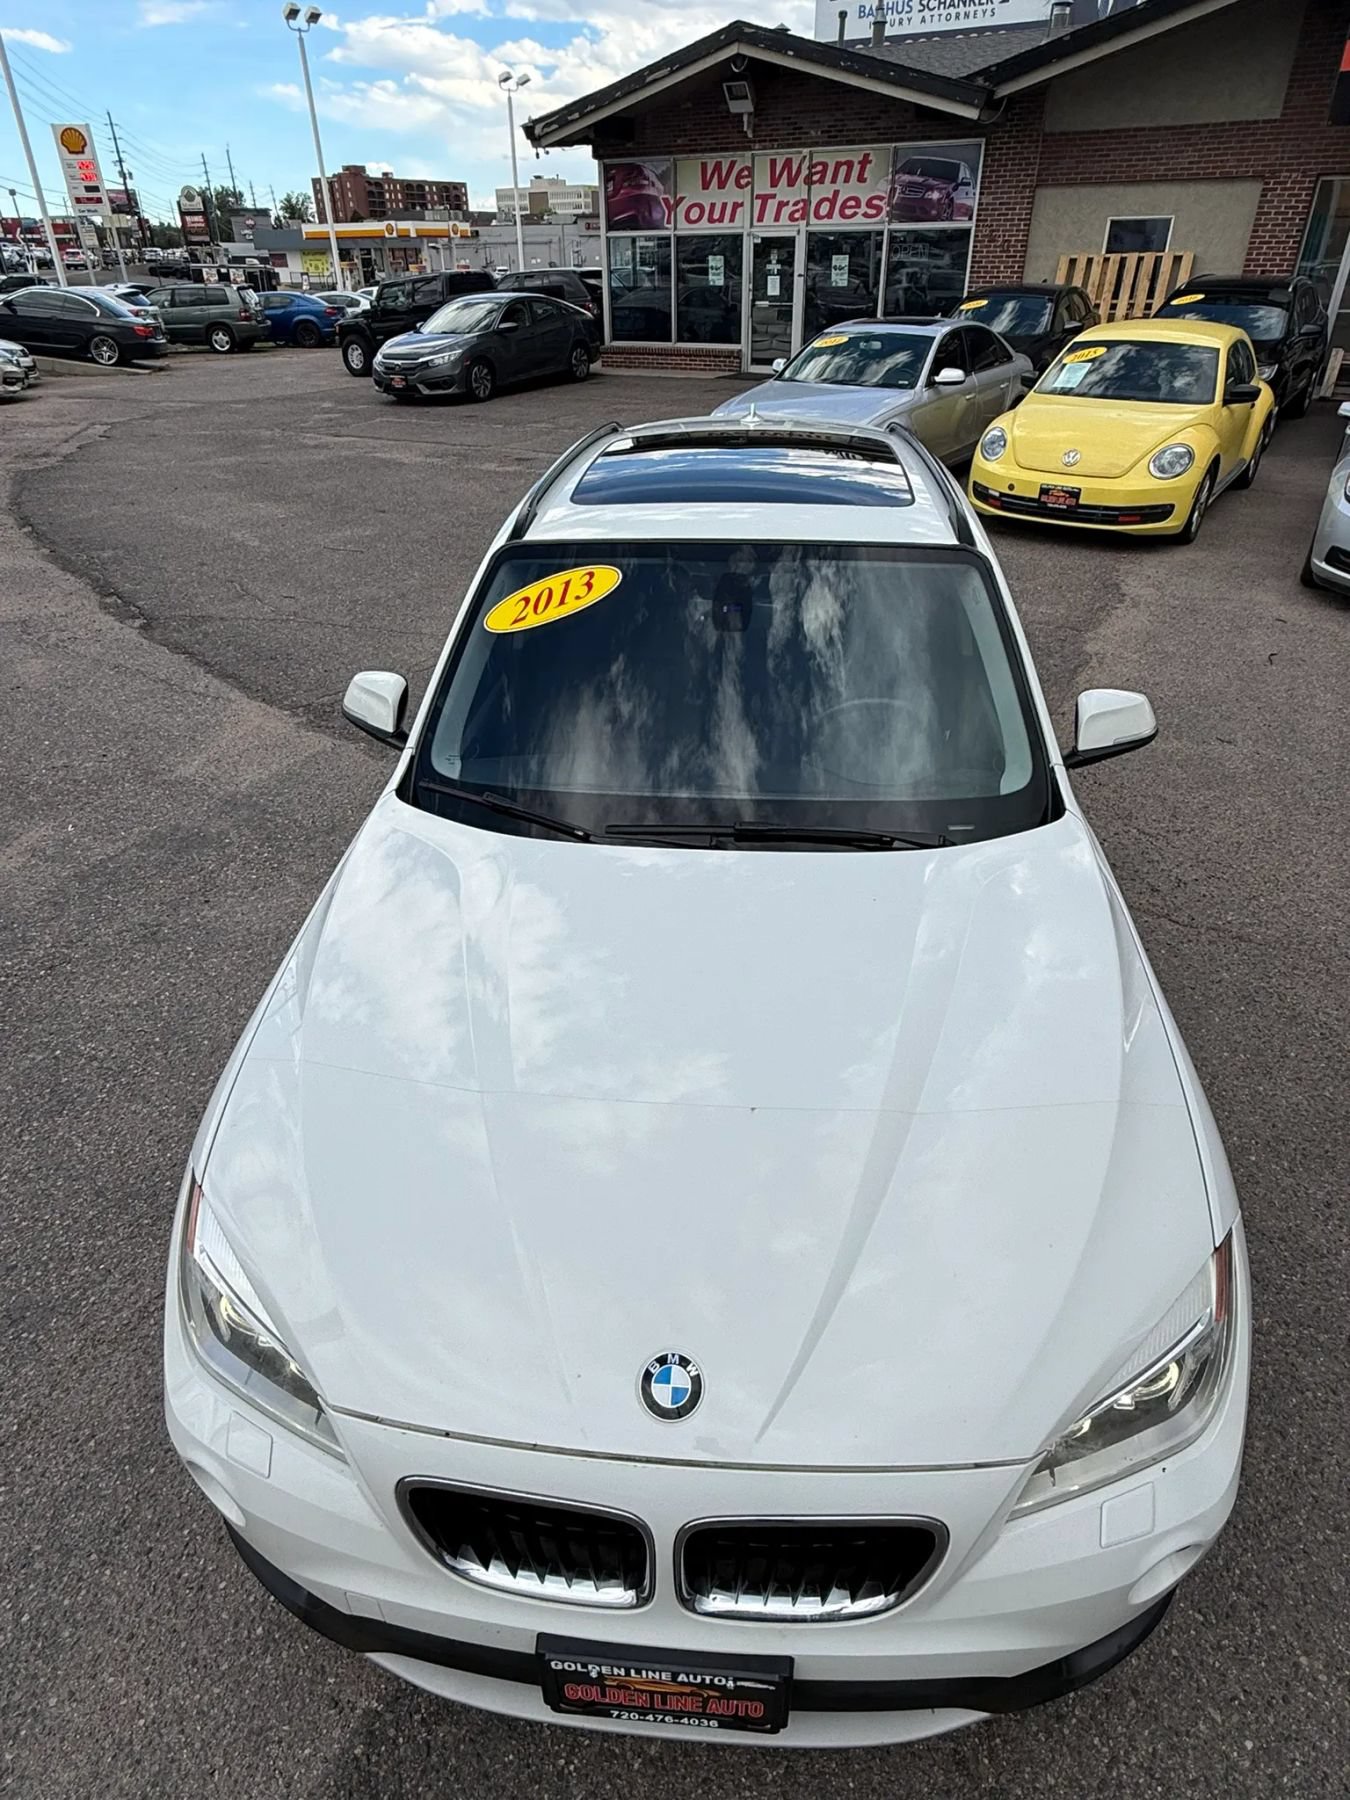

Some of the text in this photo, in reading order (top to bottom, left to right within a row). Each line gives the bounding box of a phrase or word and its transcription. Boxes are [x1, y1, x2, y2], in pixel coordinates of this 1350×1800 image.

[858, 0, 913, 19] BAHUS
[869, 8, 996, 30] IURY ATTORNEYS
[700, 152, 873, 191] We Want
[661, 189, 887, 225] Your Trades
[892, 244, 926, 259] OPEN
[510, 570, 595, 626] 2013
[648, 1353, 699, 1377] BMW
[550, 1660, 727, 1685] GOLDEN LINE AUTO
[564, 1683, 764, 1717] GOLDEN LINE AUTO
[610, 1710, 719, 1727] 720-476-4036
